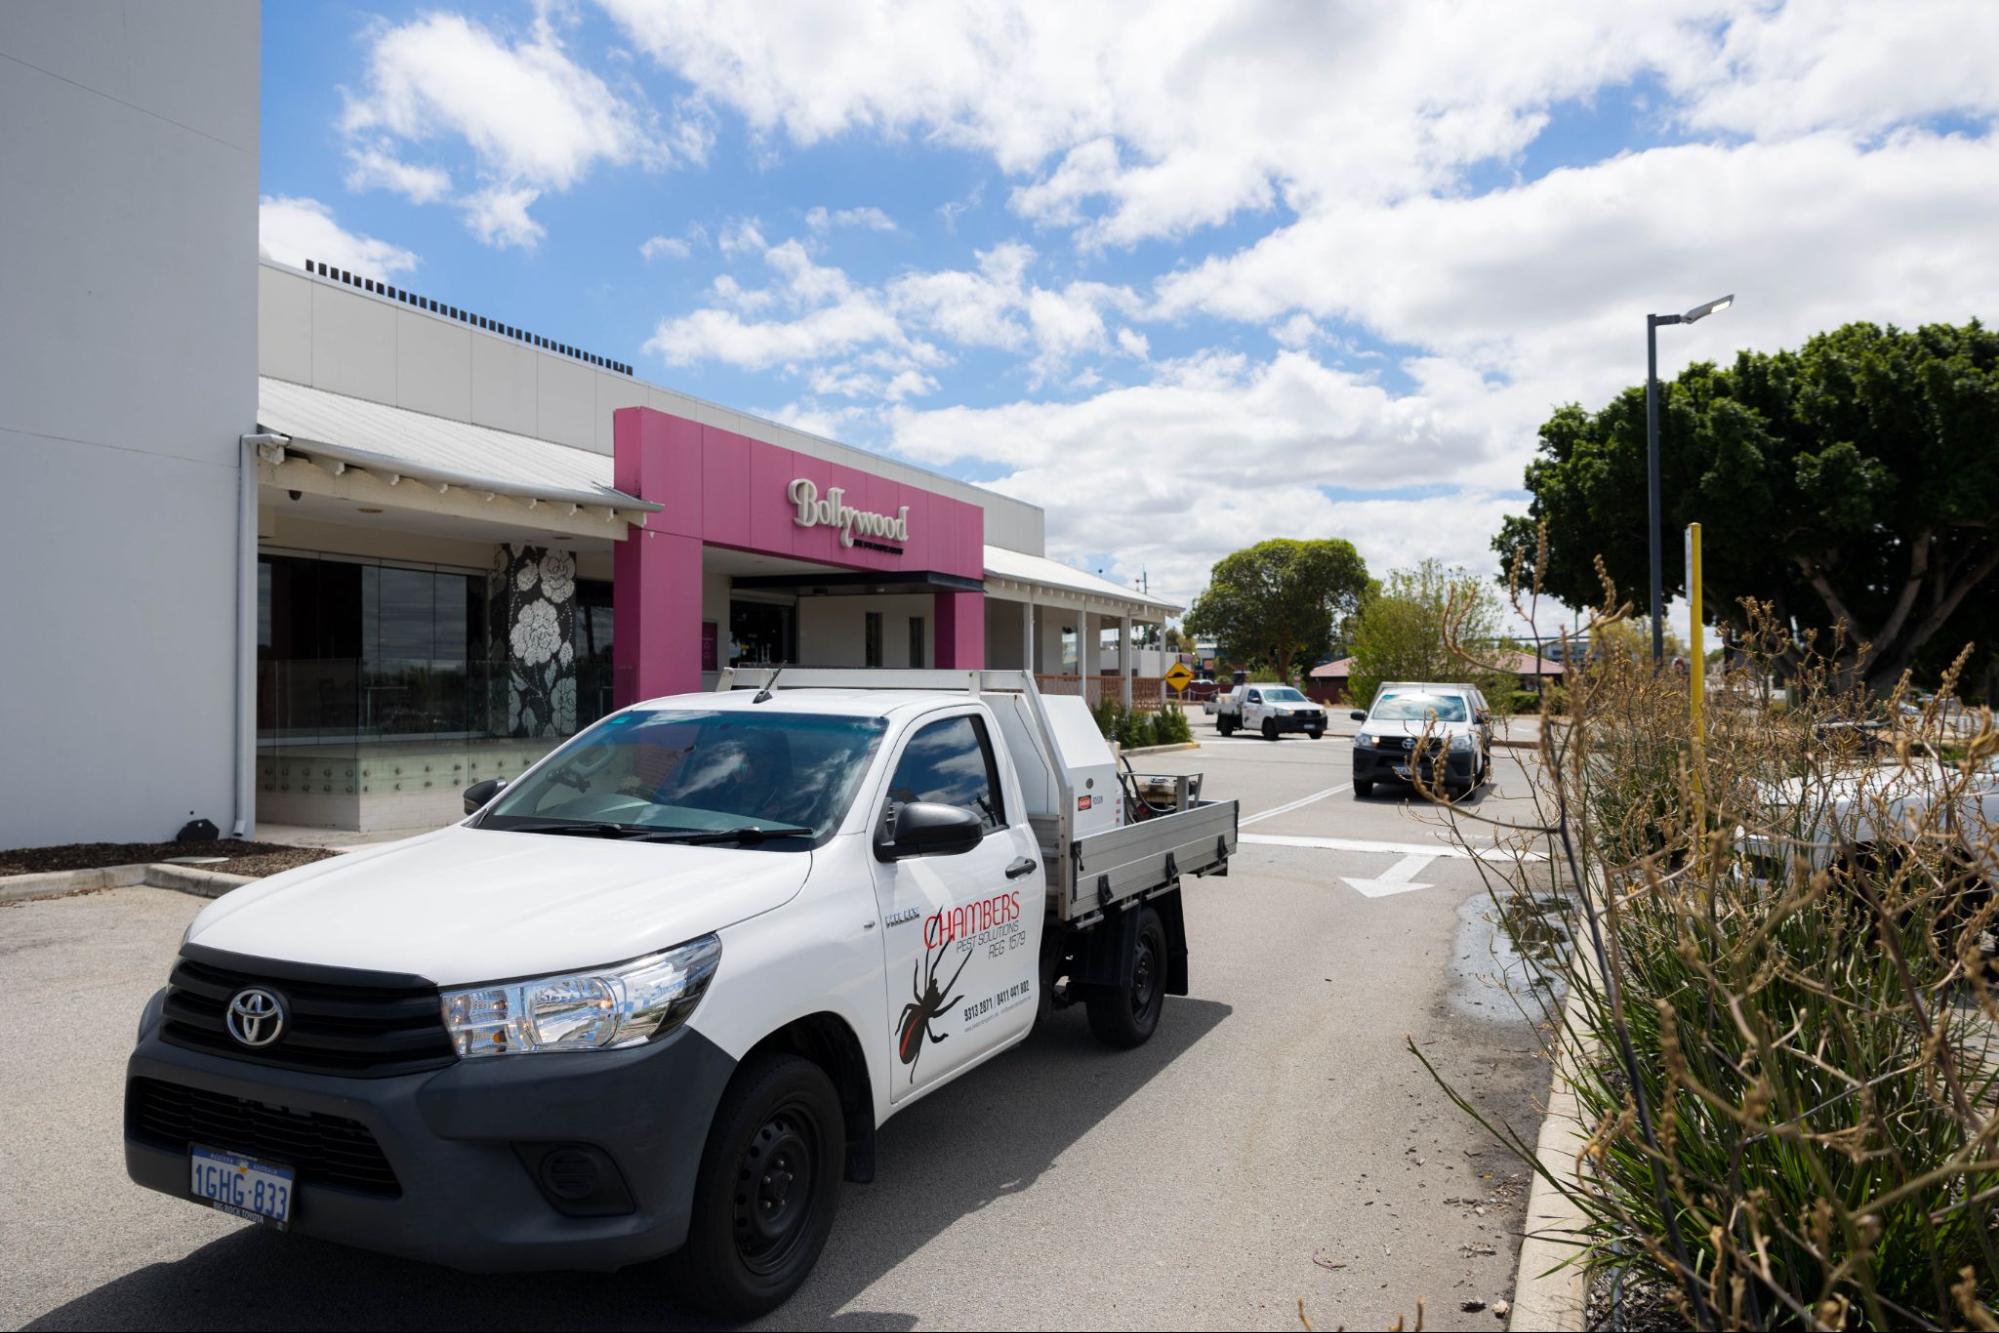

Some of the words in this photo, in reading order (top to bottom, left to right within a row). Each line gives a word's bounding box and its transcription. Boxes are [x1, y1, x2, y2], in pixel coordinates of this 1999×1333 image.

[788, 478, 909, 547] Bollywood
[924, 891, 1020, 949] CHAMBERS
[956, 936, 976, 953] PEST
[978, 920, 1019, 946] SOLUTIONS
[988, 940, 1005, 959] REG
[964, 1004, 979, 1021] 9313
